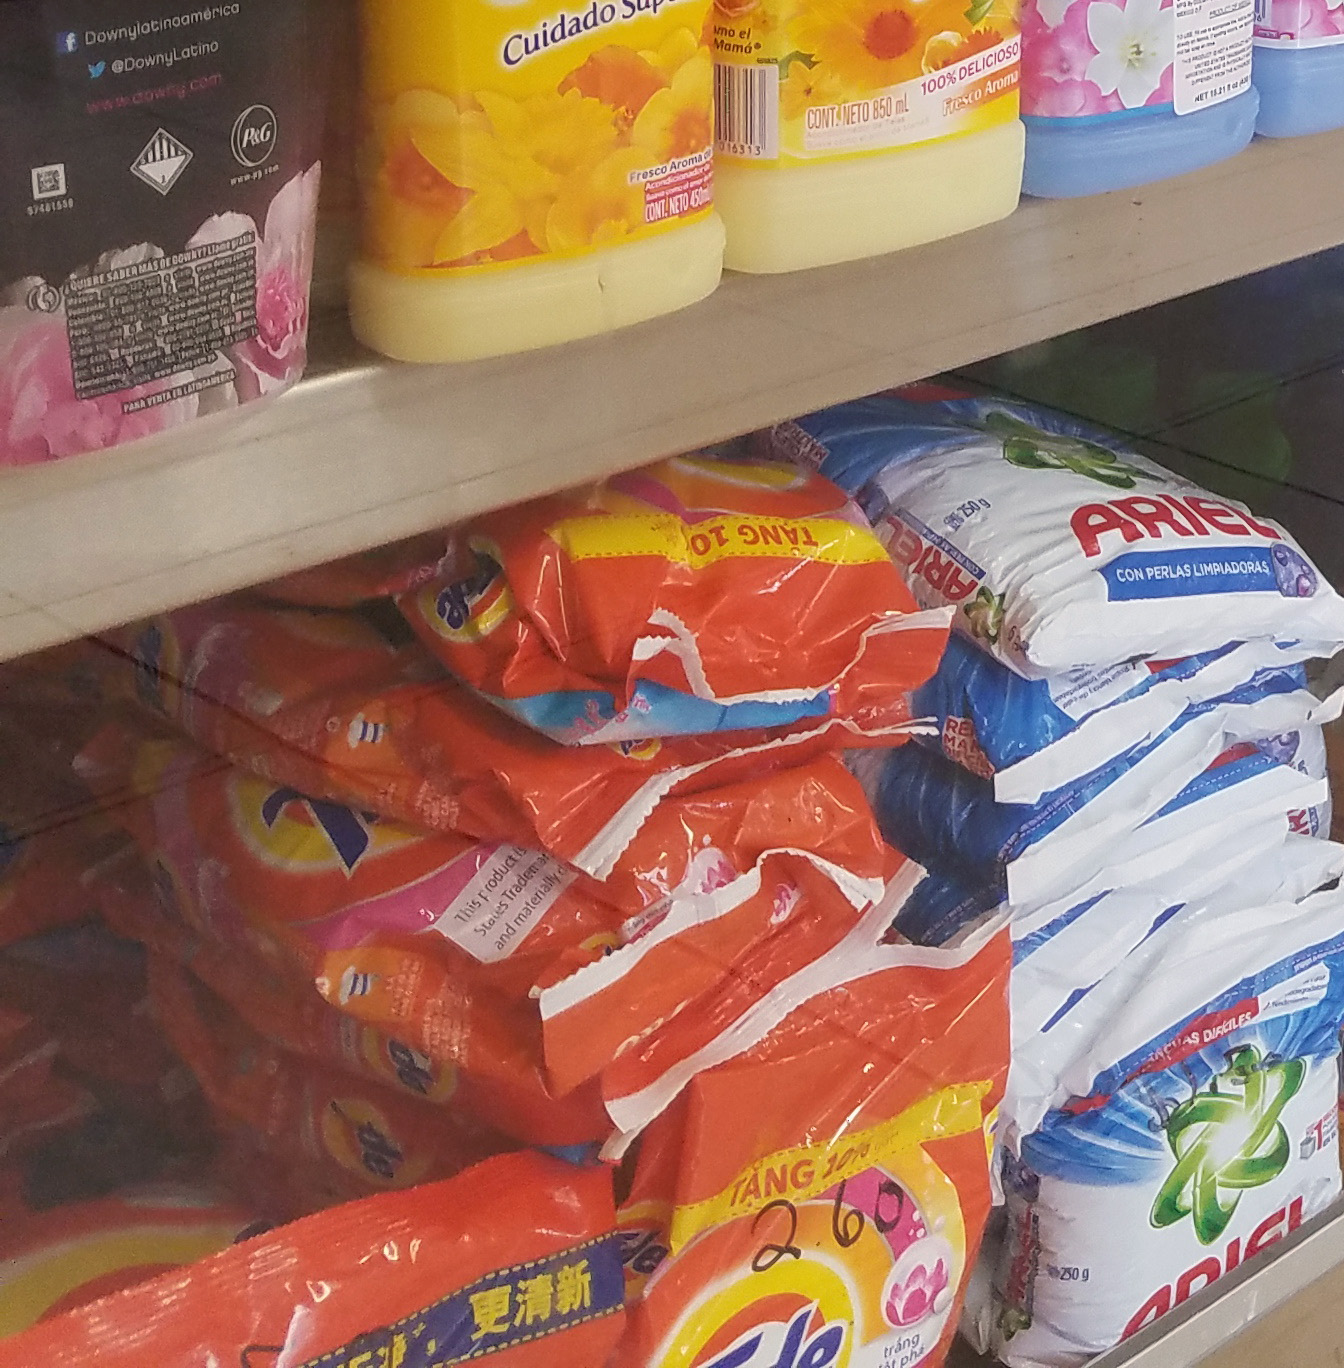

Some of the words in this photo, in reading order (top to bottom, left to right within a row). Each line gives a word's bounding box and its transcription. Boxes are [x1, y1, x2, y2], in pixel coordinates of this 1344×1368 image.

[502, 2, 616, 66] Cuidado
[738, 26, 752, 39] el
[111, 39, 220, 74] @DownyLatino
[921, 72, 957, 96] 100%
[957, 43, 1019, 81] DELICIOSO
[807, 108, 839, 130] CONT.
[842, 102, 870, 126] NETO
[871, 97, 892, 119] 850
[894, 92, 909, 114] mL
[942, 87, 983, 117] Fresco
[985, 71, 1019, 96] Aroma
[1194, 92, 1209, 103] NET
[241, 121, 273, 149] P&G
[629, 165, 668, 184] Fresco
[669, 153, 703, 172] Aroma
[645, 198, 668, 222] CONT.
[669, 192, 689, 216] NETO
[1070, 493, 1282, 558] ARIEL
[886, 515, 979, 601] ARIEL
[1115, 566, 1143, 583] CON
[1145, 563, 1191, 580] PERLAS
[1193, 559, 1270, 578] LIMPIADORAS
[454, 898, 482, 924] This
[481, 856, 520, 903] product
[494, 924, 518, 951] and
[514, 873, 561, 927] materially
[1059, 1266, 1080, 1281] 250
